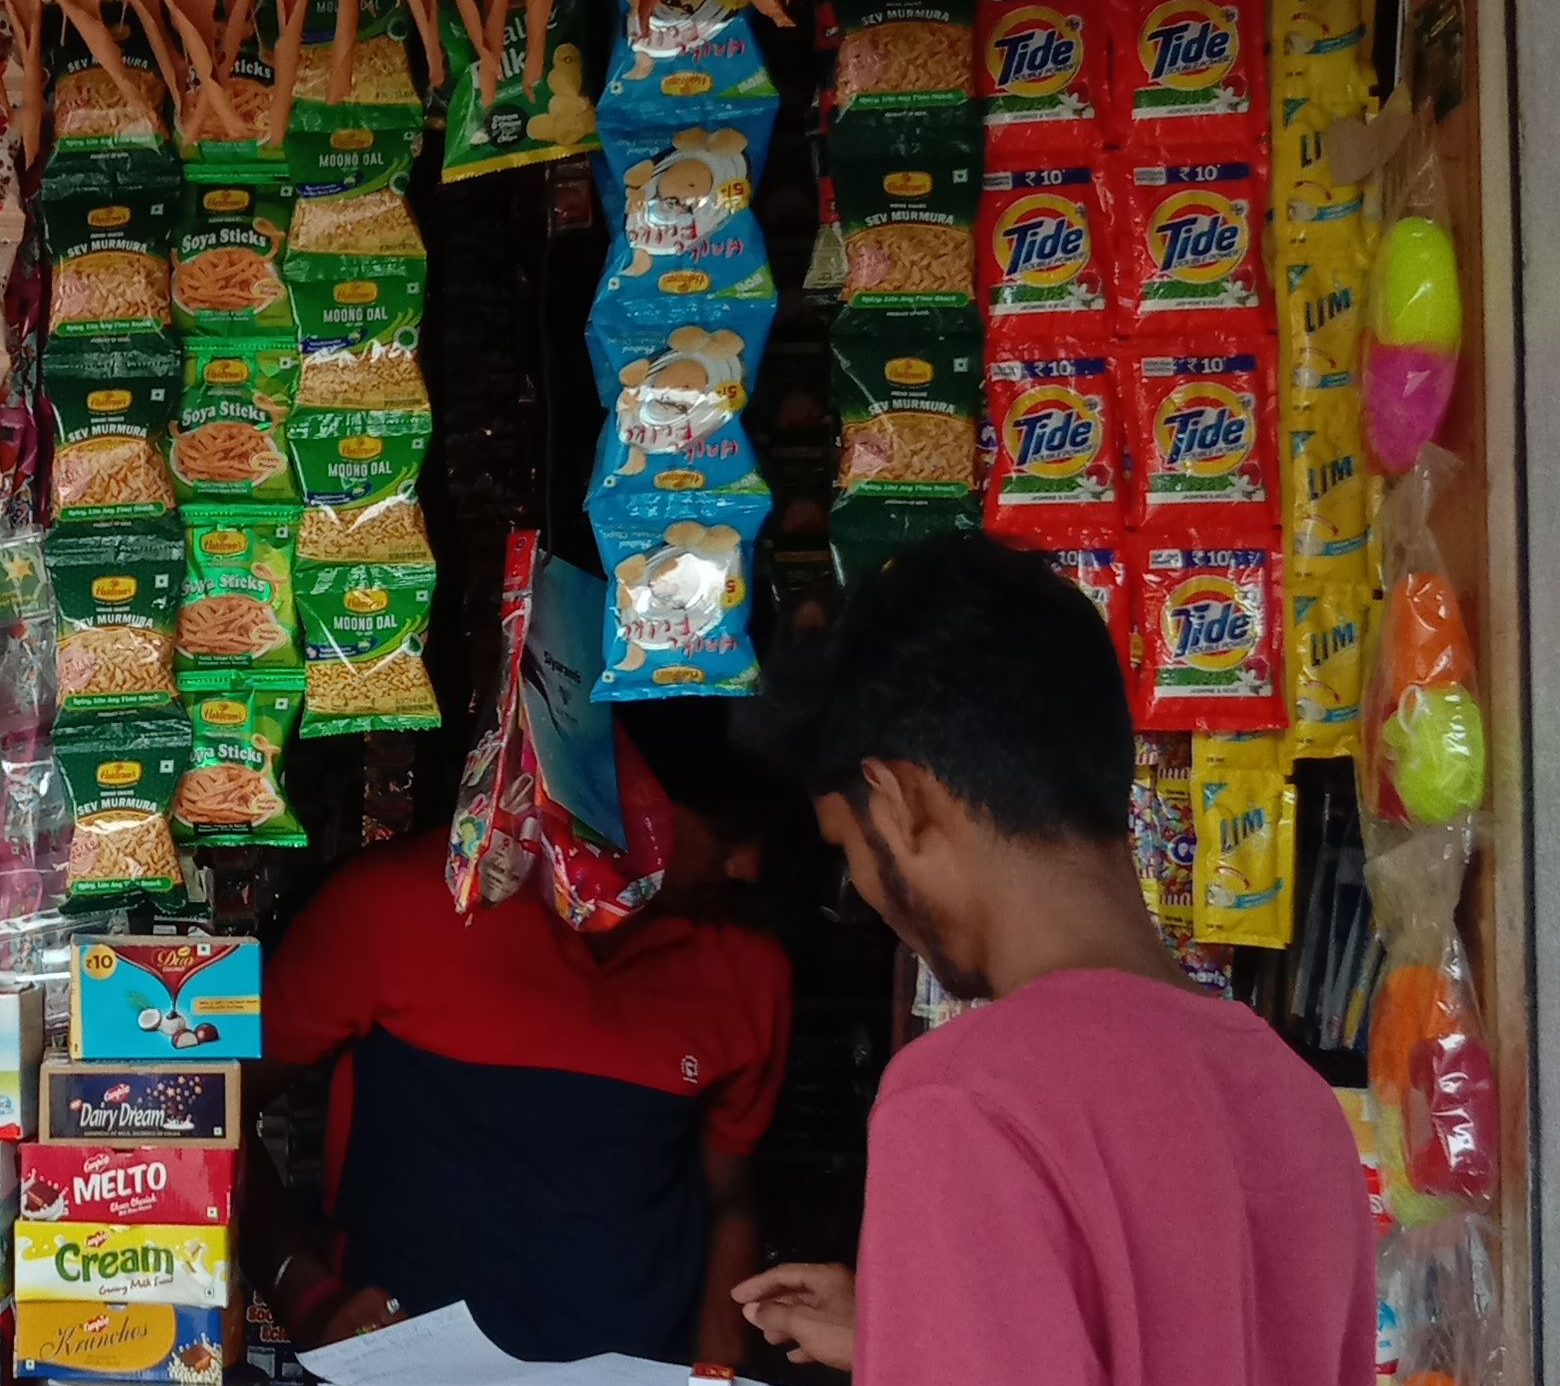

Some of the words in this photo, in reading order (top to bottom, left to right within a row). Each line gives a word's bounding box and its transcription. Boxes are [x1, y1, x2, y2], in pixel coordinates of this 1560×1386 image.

[994, 30, 1076, 86] Tide
[1146, 19, 1231, 79] Tide
[318, 153, 359, 168] MOONG
[362, 152, 385, 166] DAL
[67, 241, 90, 258] SEV
[91, 239, 148, 254] MURMURA
[181, 231, 217, 254] Soya
[220, 228, 267, 248] Sticks
[1002, 216, 1085, 276] Tide
[1156, 213, 1241, 272] Tide
[323, 305, 366, 322] MOONG
[181, 404, 216, 426] Soya
[220, 403, 266, 423] Sticks
[68, 426, 90, 443] SEV
[92, 424, 148, 439] MURMURA
[1011, 409, 1094, 469] Tide
[370, 460, 393, 476] DAL
[97, 613, 154, 629] MURMURA
[80, 1102, 118, 1131] Dairy
[119, 1103, 166, 1129] Dream
[73, 1161, 168, 1205] MELTO
[55, 1242, 174, 1282] Cream
